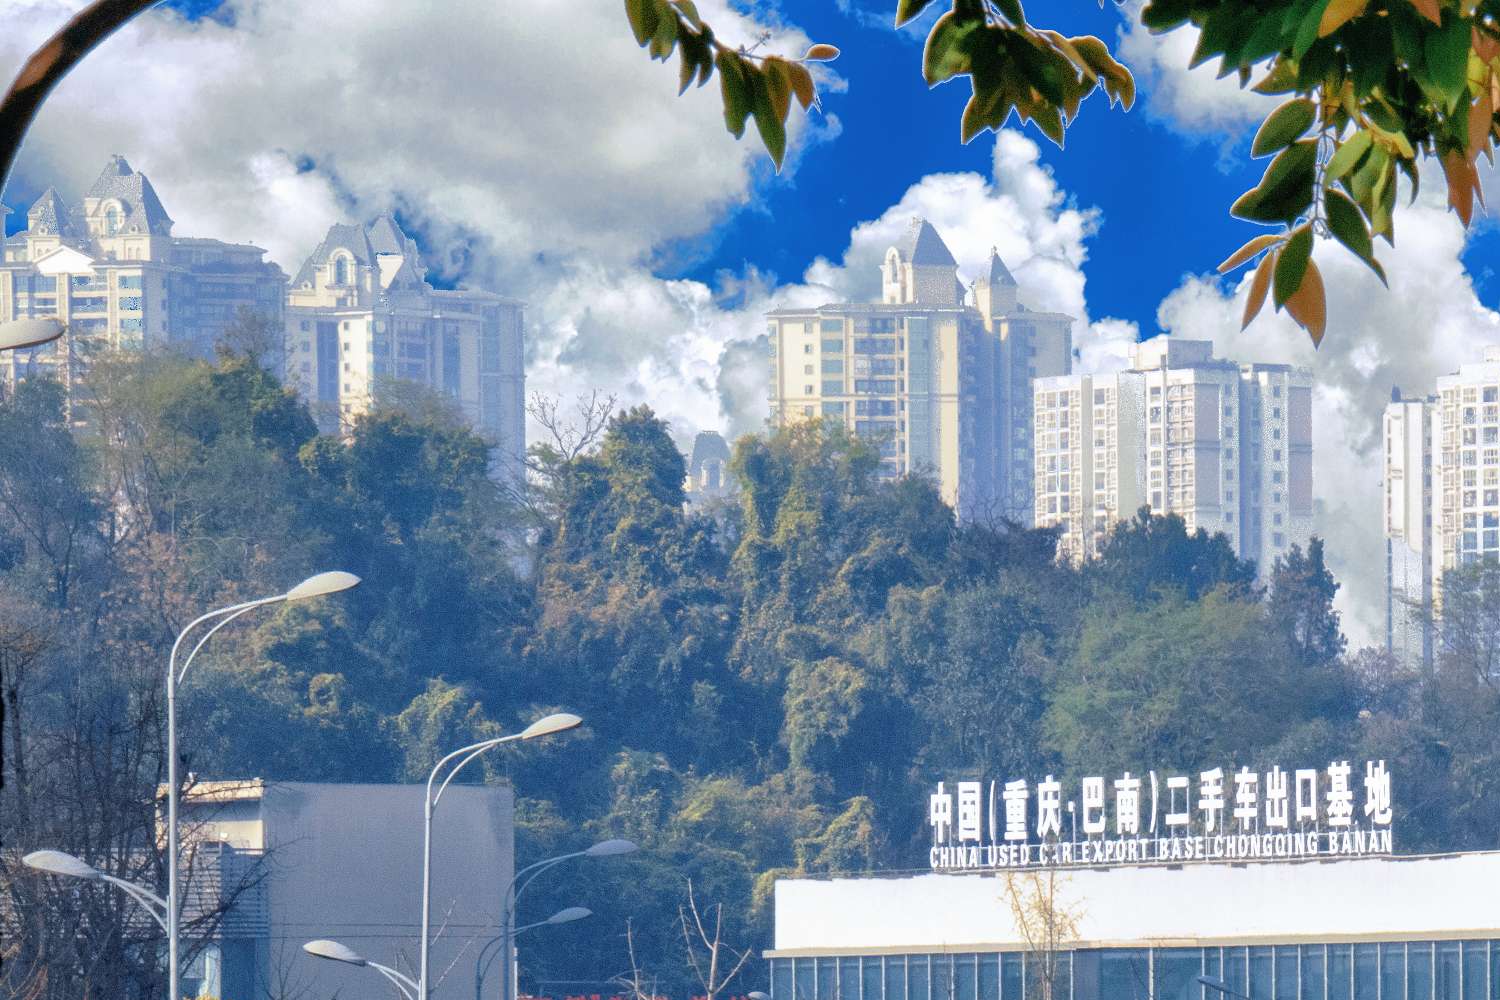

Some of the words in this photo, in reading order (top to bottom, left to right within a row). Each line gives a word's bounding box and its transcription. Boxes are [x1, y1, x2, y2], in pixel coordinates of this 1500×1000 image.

[929, 846, 979, 868] CHINA
[987, 844, 1030, 866] USED
[1039, 842, 1073, 864] CAR
[1081, 838, 1150, 862] EXPORT
[1159, 836, 1203, 860] BASE
[1213, 832, 1319, 858] CHONGQING
[1328, 829, 1393, 855] BANAN
